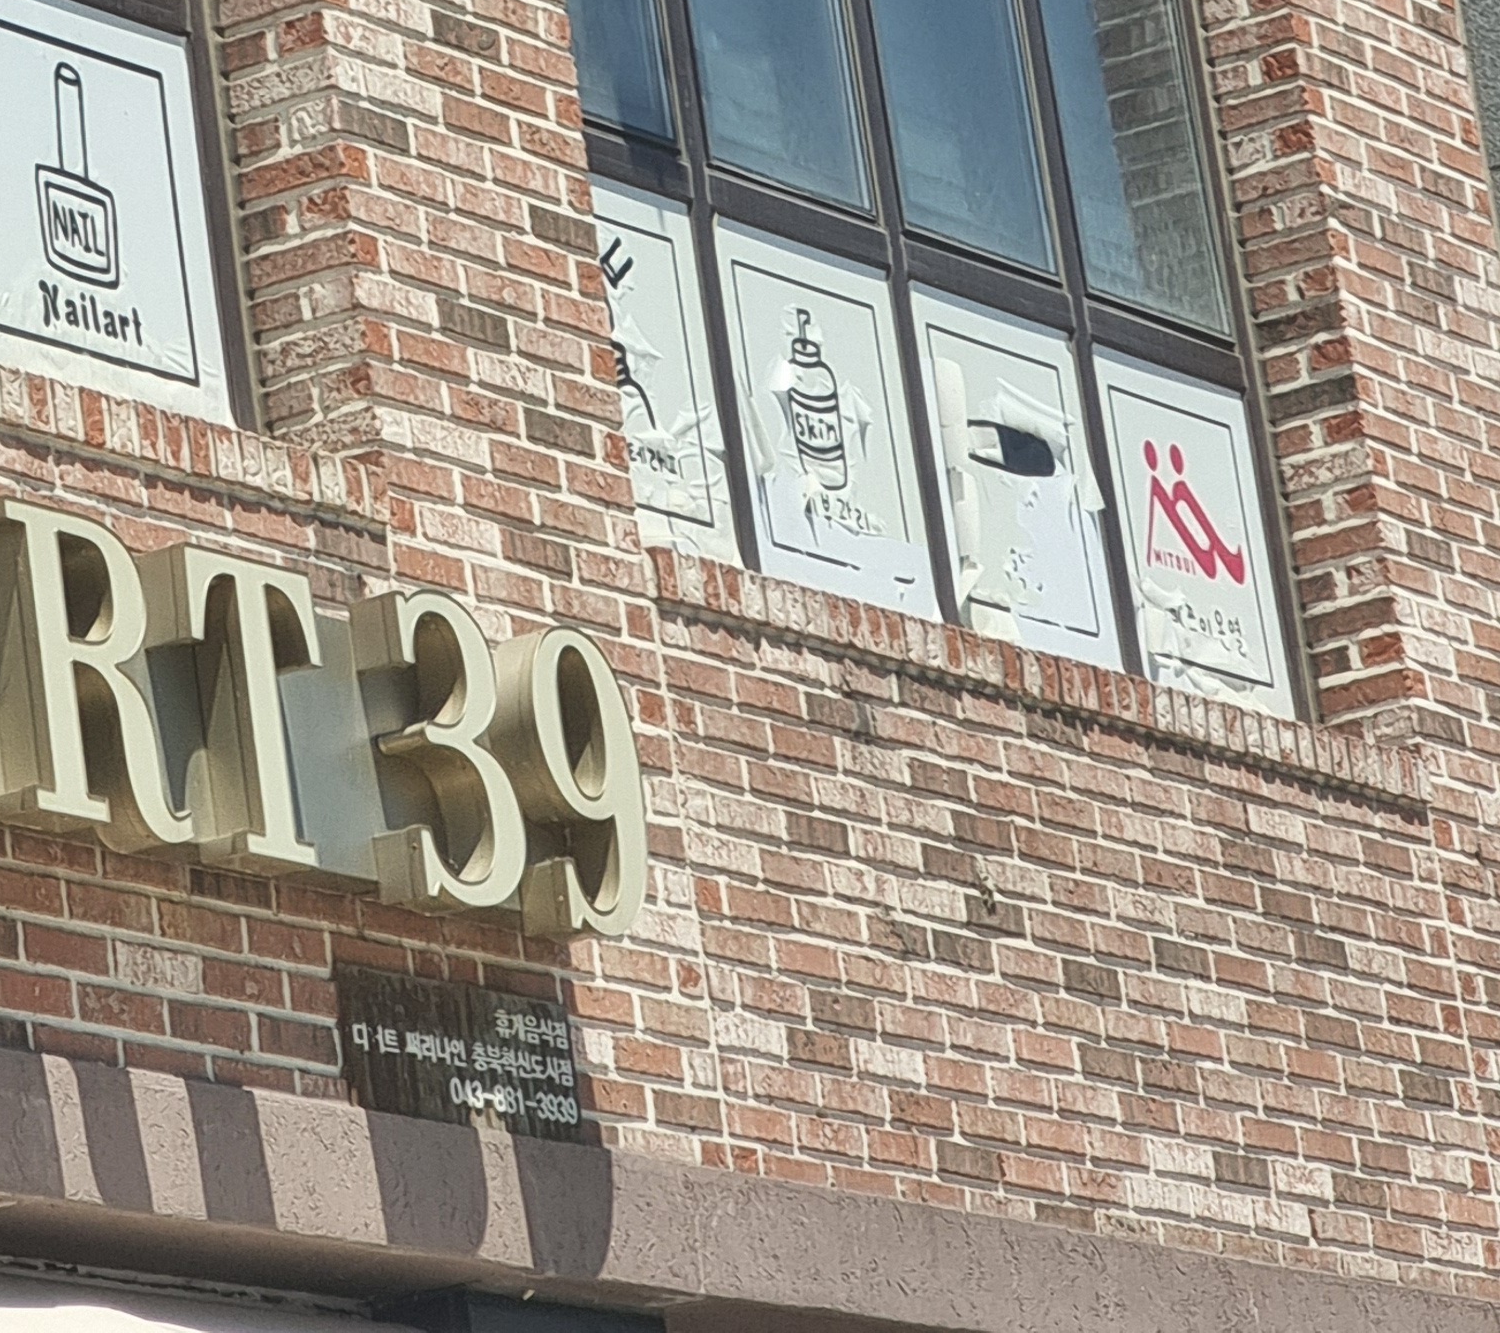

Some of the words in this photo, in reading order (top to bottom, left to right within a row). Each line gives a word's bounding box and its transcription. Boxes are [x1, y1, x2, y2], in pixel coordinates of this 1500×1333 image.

[51, 199, 109, 259] NAIL
[39, 279, 144, 347] Nailart
[795, 412, 839, 443] Skin
[1153, 547, 1197, 576] MITSUI
[390, 588, 649, 936] 39
[493, 1008, 569, 1051] 휴게음식점
[470, 1042, 575, 1088] 충북혁신도시점
[450, 1077, 579, 1126] 043-881-3939
